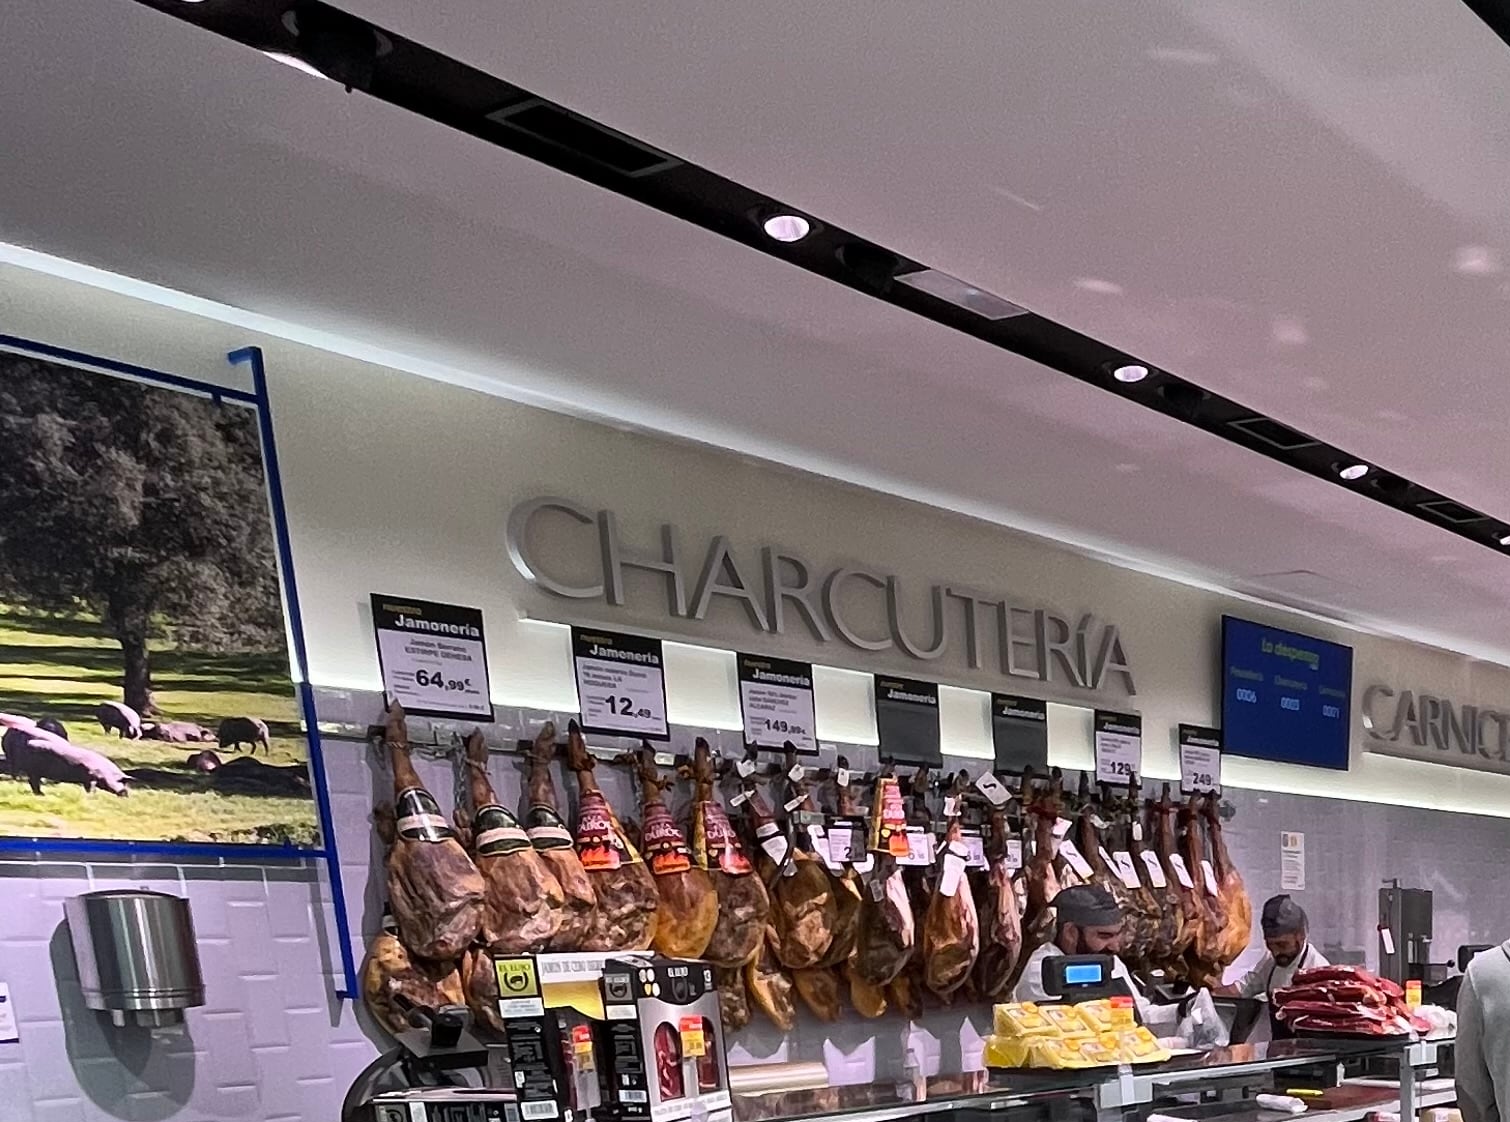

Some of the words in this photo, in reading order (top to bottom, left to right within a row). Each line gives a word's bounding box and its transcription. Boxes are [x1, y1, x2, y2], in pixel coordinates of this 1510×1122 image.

[503, 494, 1137, 695] CHARCUTERÍA
[394, 613, 481, 637] Jamonería
[589, 644, 660, 664] Jamonería
